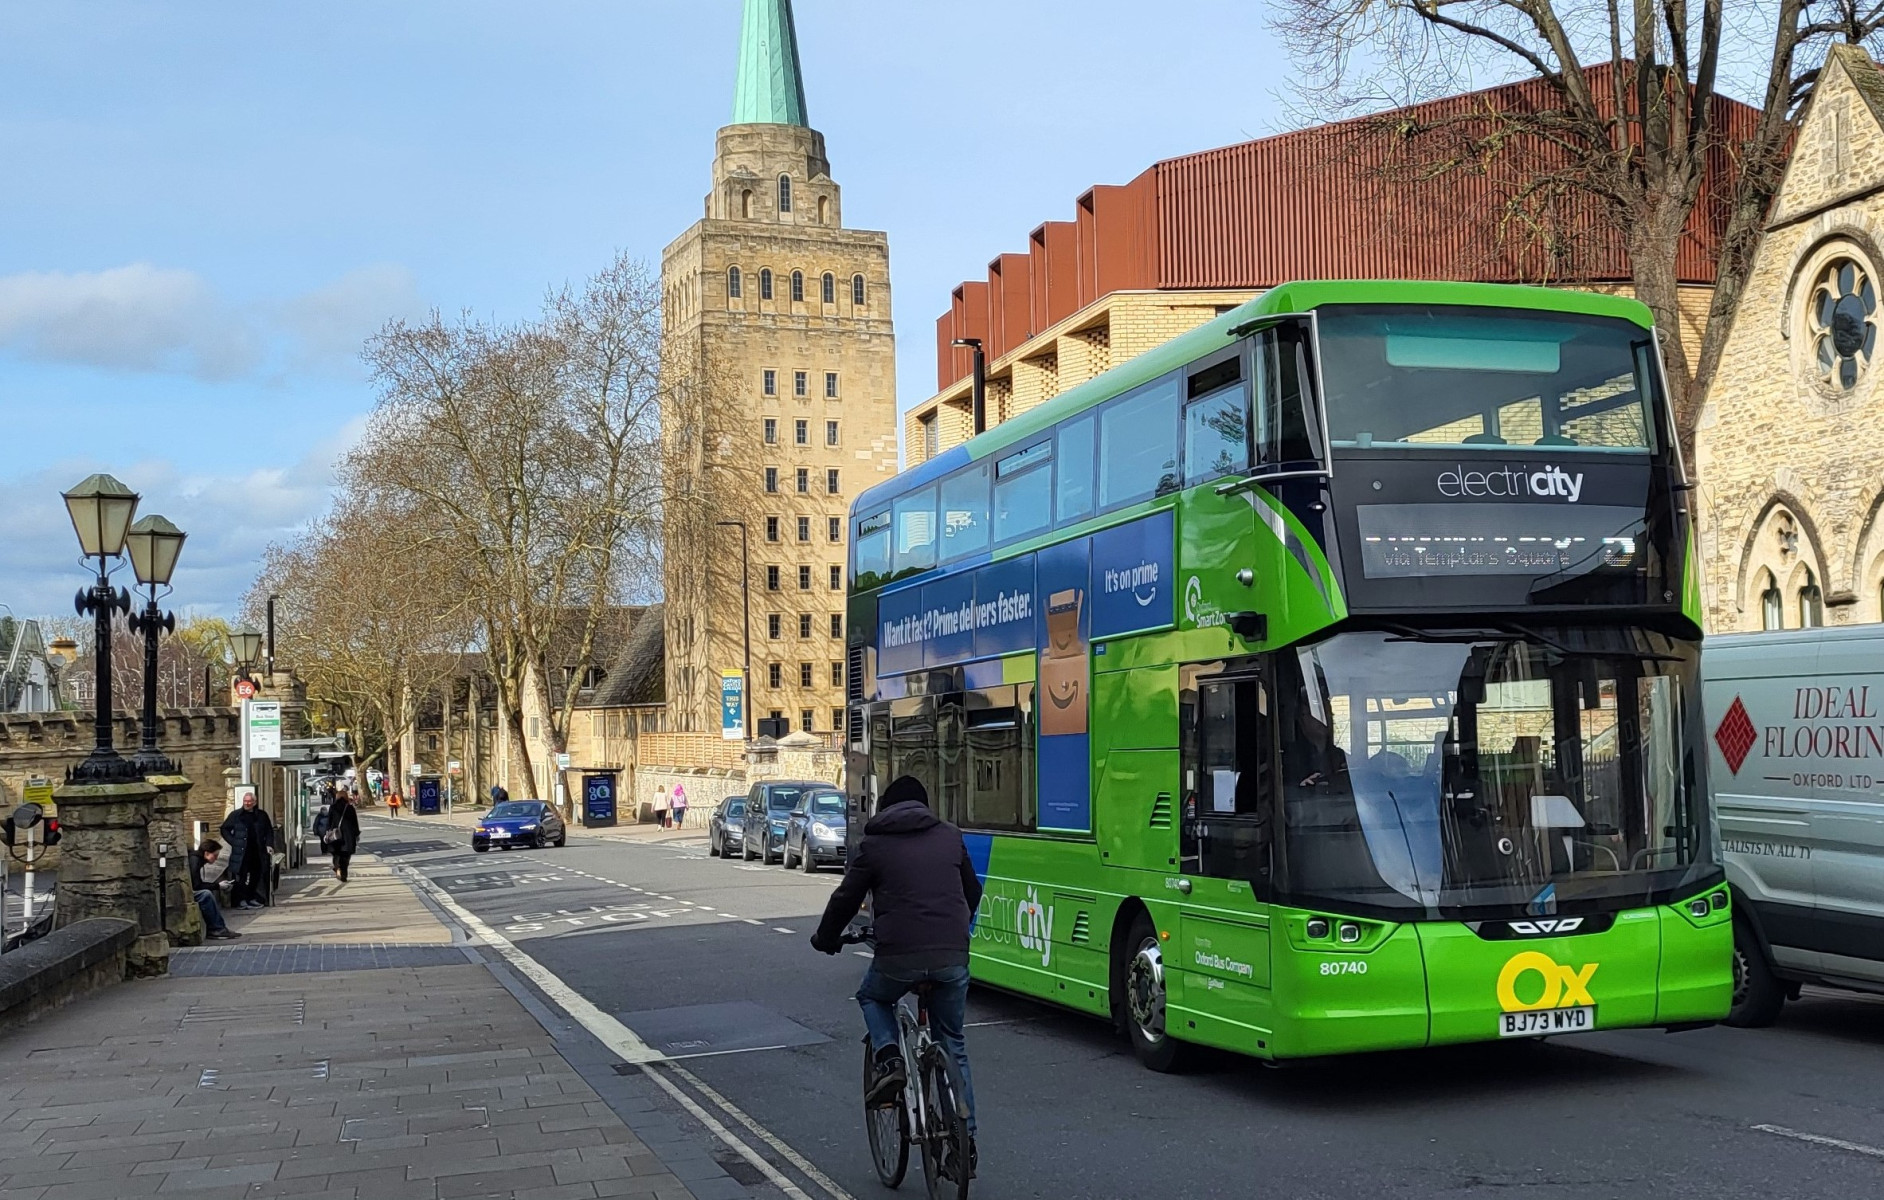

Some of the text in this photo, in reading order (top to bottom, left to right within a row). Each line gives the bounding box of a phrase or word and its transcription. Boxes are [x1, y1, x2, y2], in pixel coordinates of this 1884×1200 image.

[1437, 463, 1584, 502] electricity
[1384, 547, 1571, 567] via Templars Square
[1105, 560, 1158, 593] It's on prime
[884, 589, 1032, 648] Want it fast? Prime delvers faster.
[239, 686, 252, 695] E6
[1793, 686, 1877, 719] IDEAL
[1793, 773, 1872, 788] OXFORD LTD
[1763, 843, 1777, 856] IN
[1777, 845, 1797, 858] ALL
[504, 908, 693, 934] STOP
[512, 903, 653, 922] BUS
[1214, 954, 1225, 970] Bus
[1225, 956, 1253, 979] Company
[1319, 961, 1368, 976] 80740
[1496, 951, 1600, 1012] Ox
[1505, 1009, 1586, 1033] BJ73 WYD
